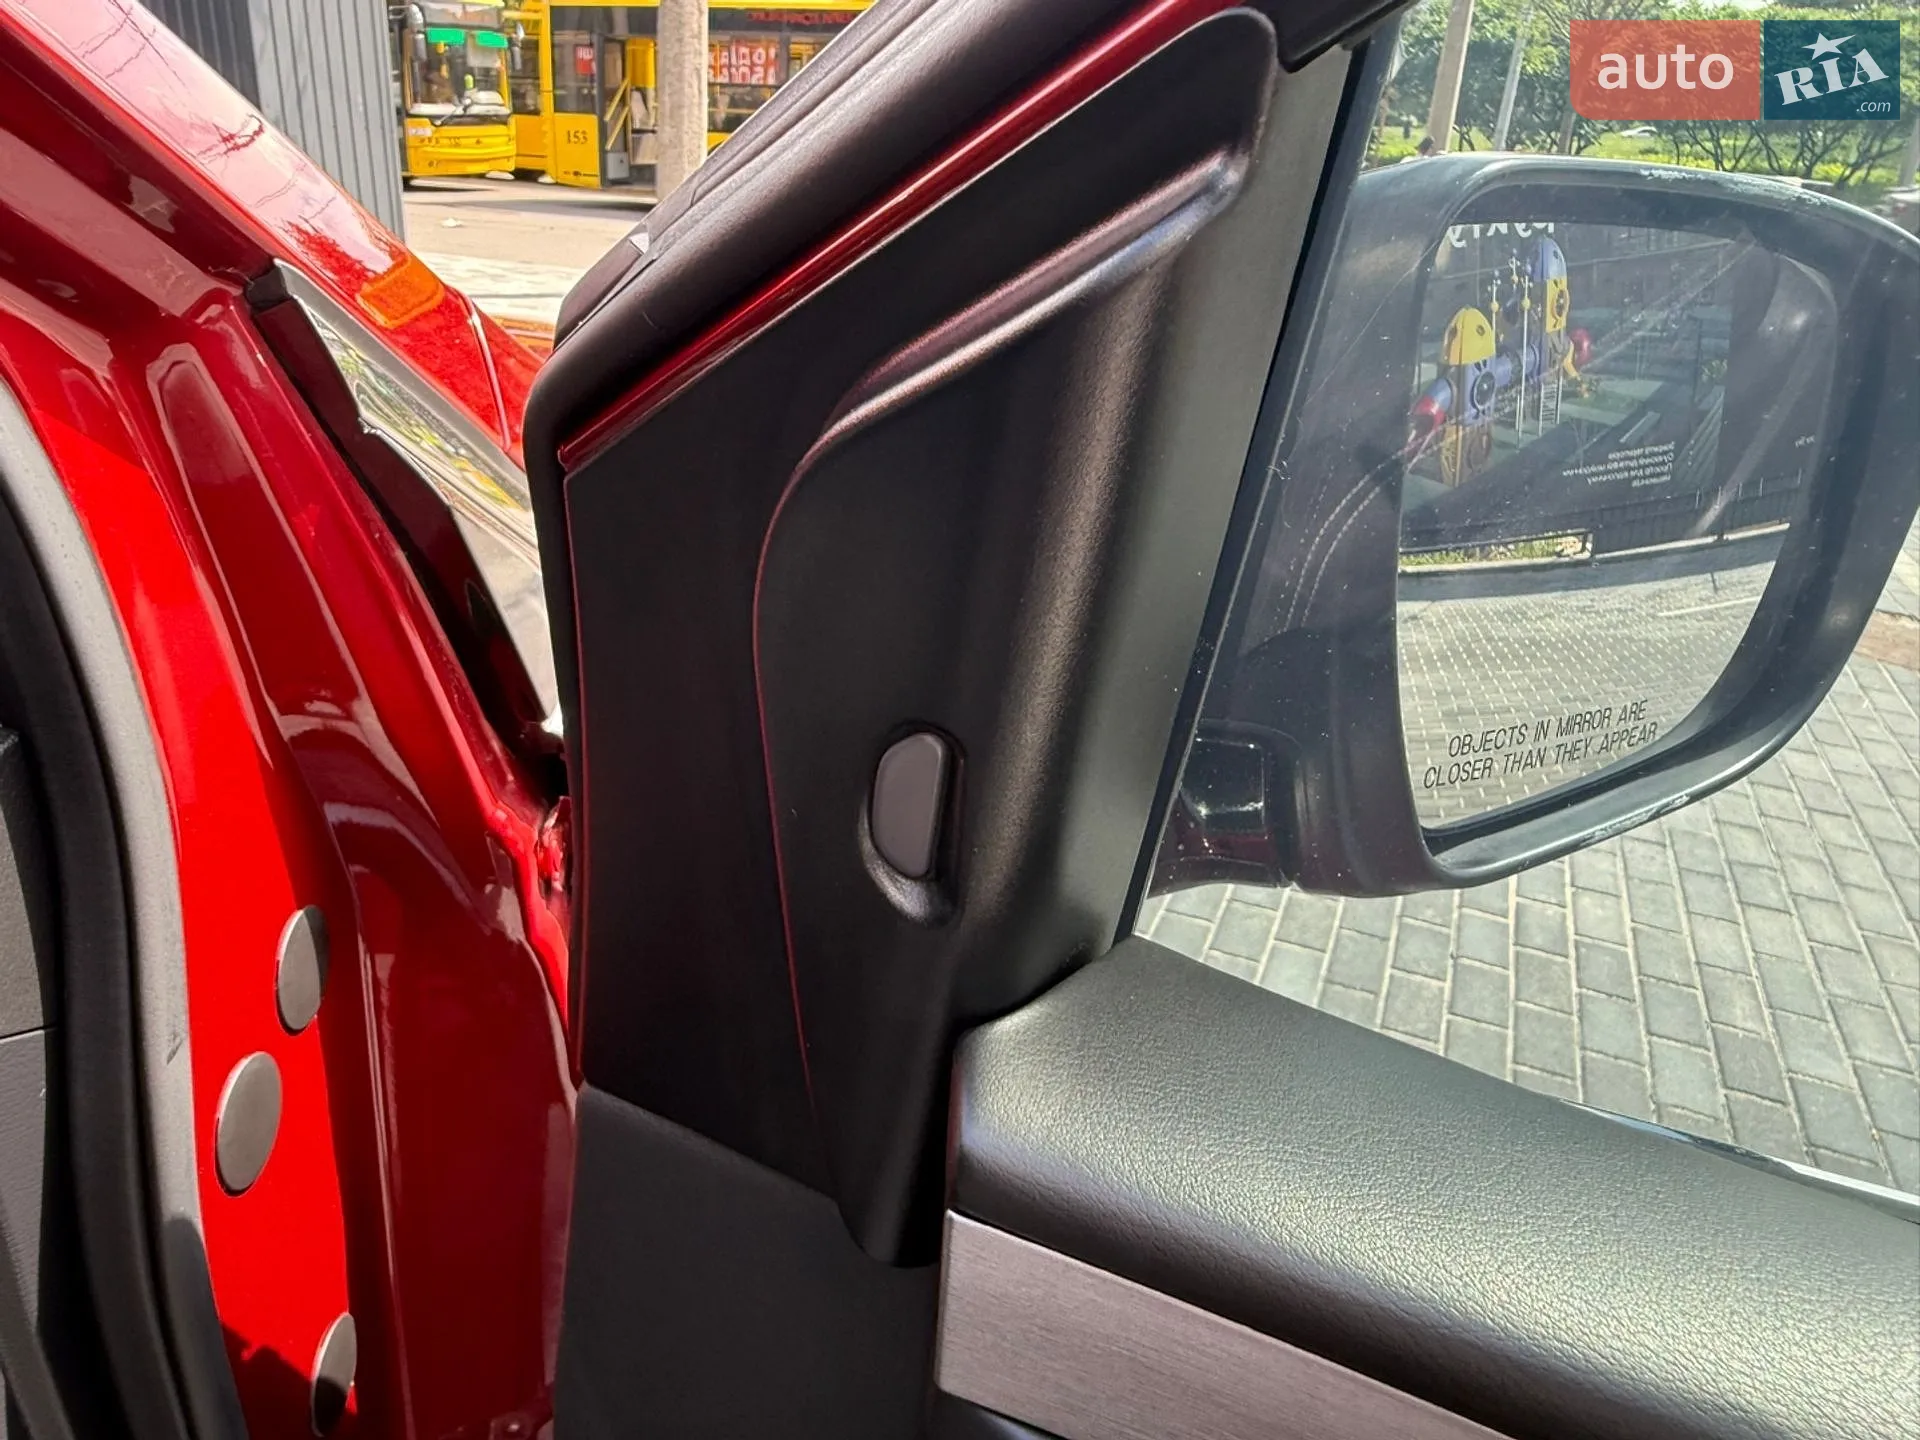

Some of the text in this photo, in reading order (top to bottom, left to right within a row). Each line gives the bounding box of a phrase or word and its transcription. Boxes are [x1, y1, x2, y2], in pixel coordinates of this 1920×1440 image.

[566, 130, 588, 145] 153
[1424, 722, 1657, 789] CLOSER THAN THEY APPEAR
[1448, 699, 1648, 757] OBJECTS IN MIRROR ARE
